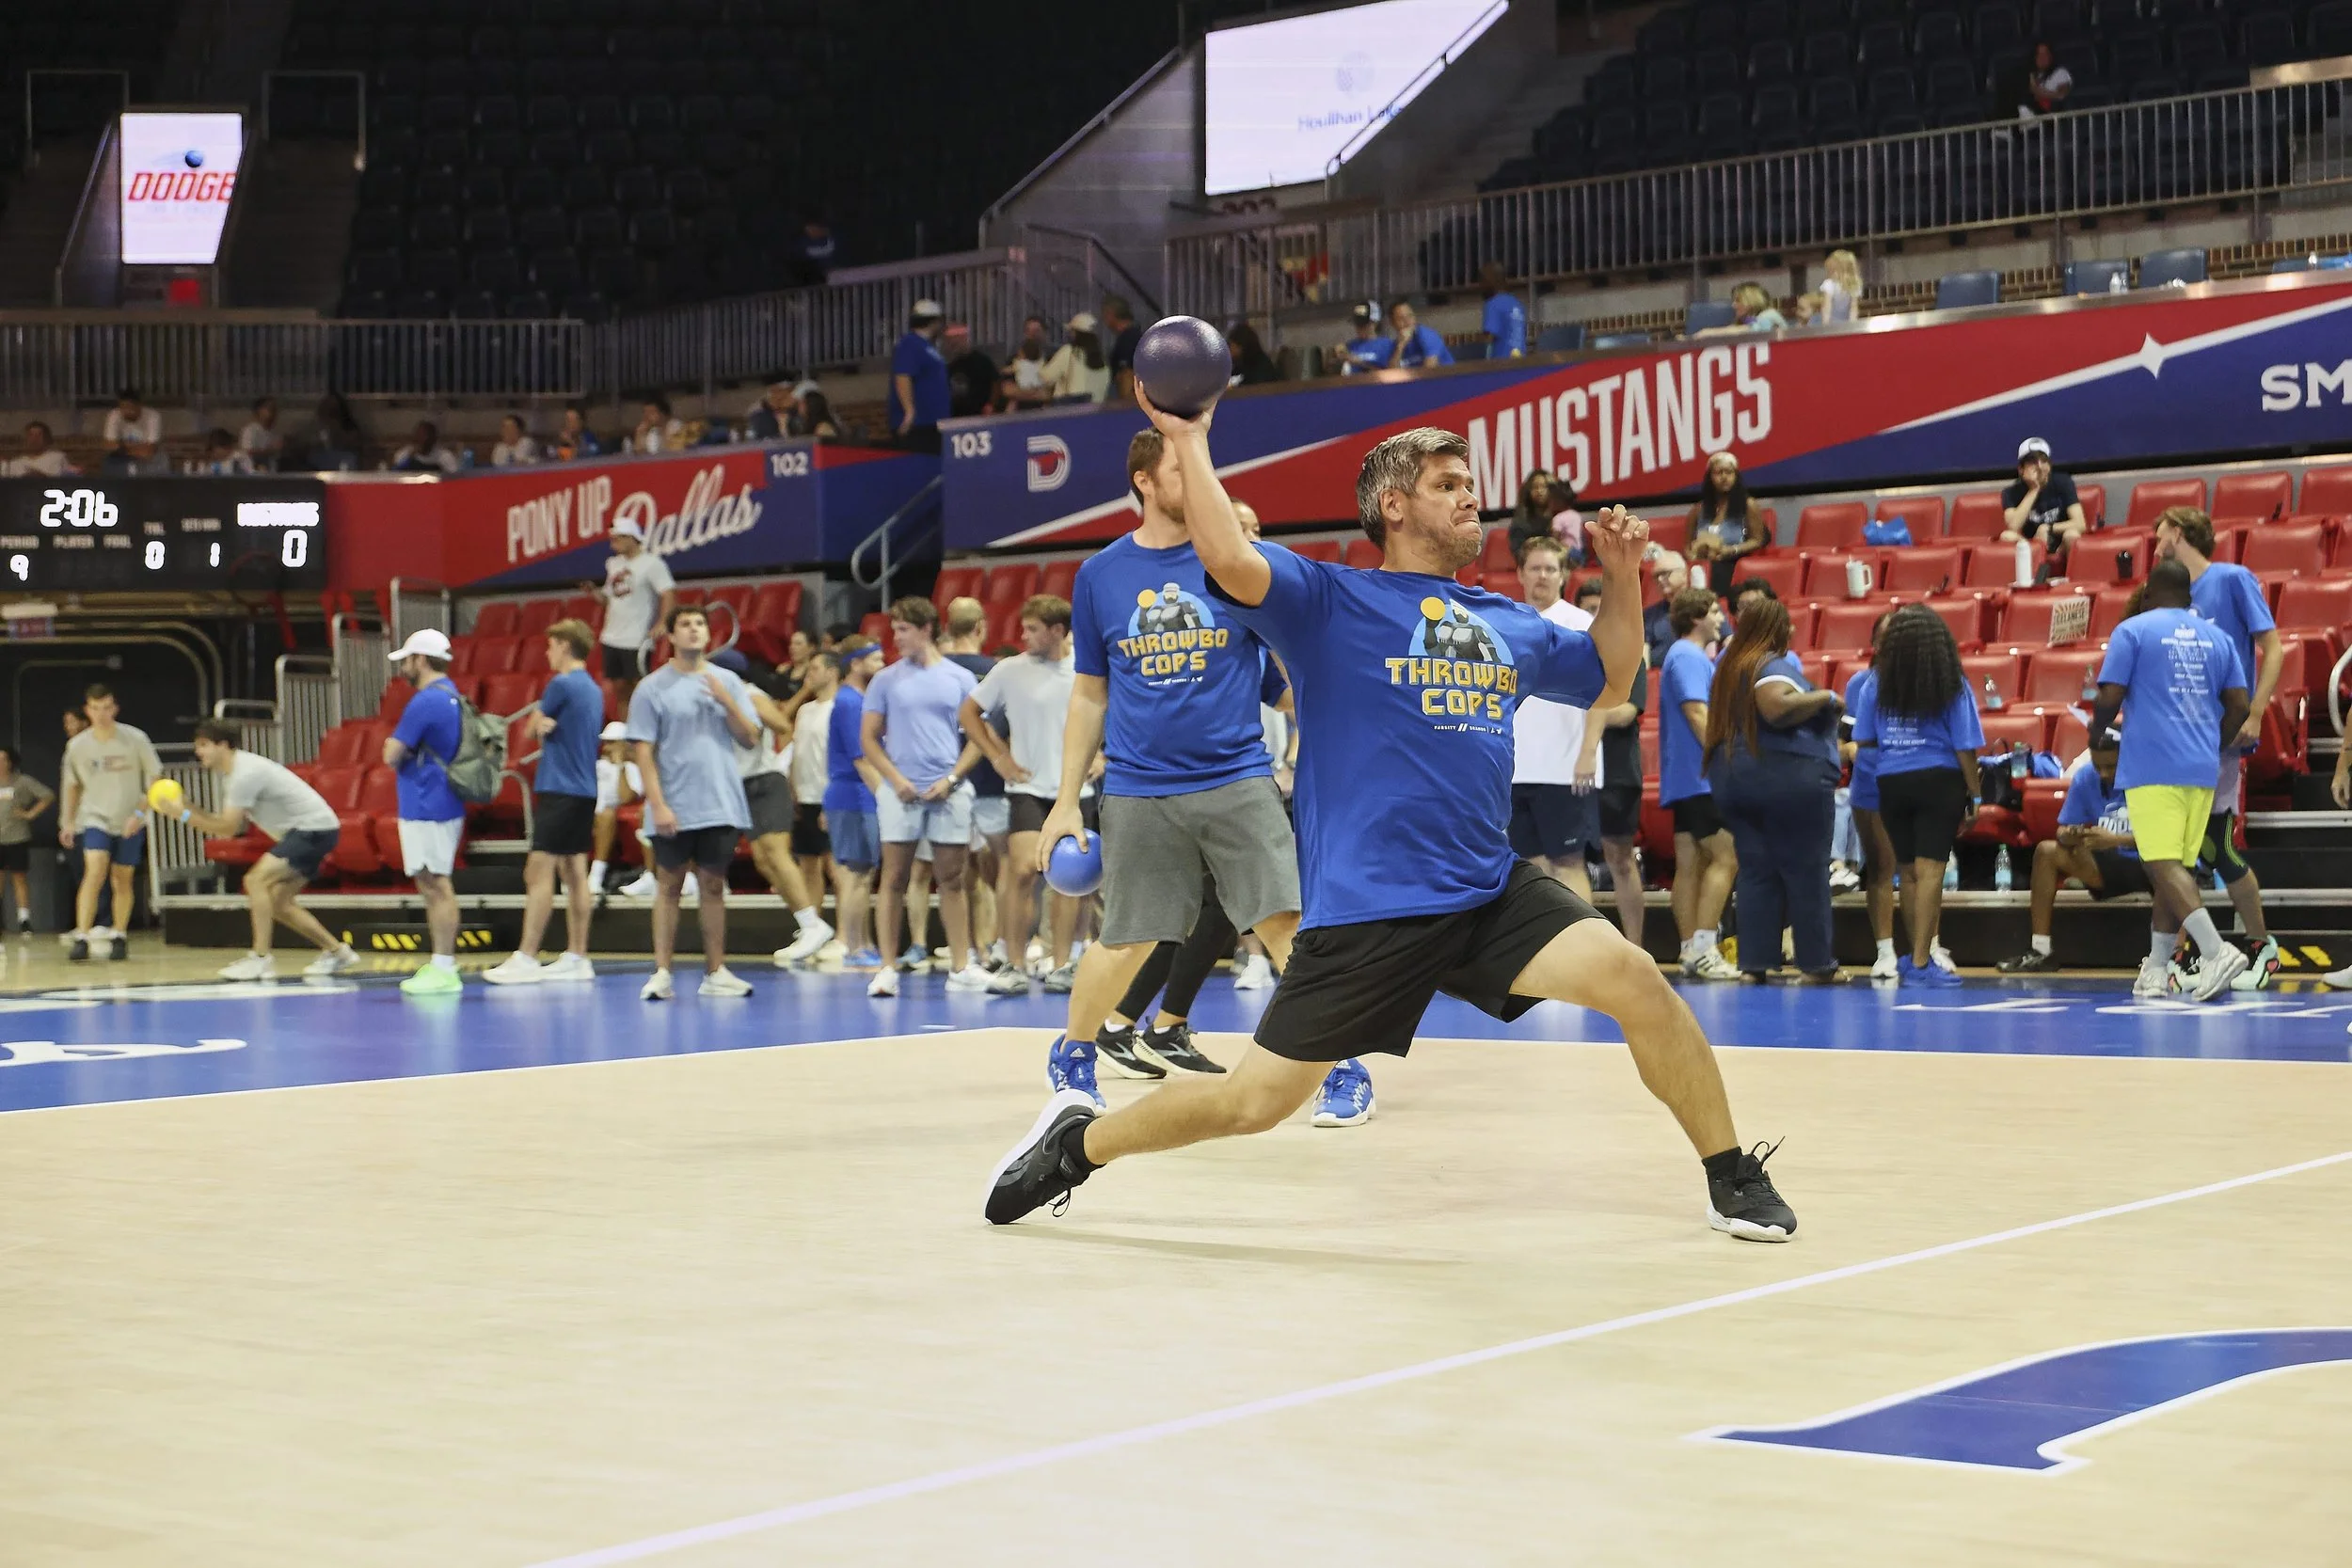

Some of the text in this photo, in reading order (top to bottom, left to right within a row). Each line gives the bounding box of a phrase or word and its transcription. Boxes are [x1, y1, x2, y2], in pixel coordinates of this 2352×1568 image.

[128, 172, 237, 203] DODGE
[2261, 358, 2352, 412] SM
[1468, 341, 1772, 511] MUSTANGS
[950, 431, 993, 459] 103
[771, 451, 808, 478] 102
[40, 489, 119, 527] 2:06
[506, 474, 612, 564] PONY UP
[612, 464, 763, 557] Dallas
[145, 541, 166, 570] 0
[210, 543, 221, 567] 1
[282, 530, 308, 567] 0
[9, 554, 30, 581] 9
[1118, 628, 1230, 658] THROWBO
[1140, 650, 1209, 676] COPS
[1385, 657, 1518, 695] THROWBO
[1422, 688, 1503, 720] COPS
